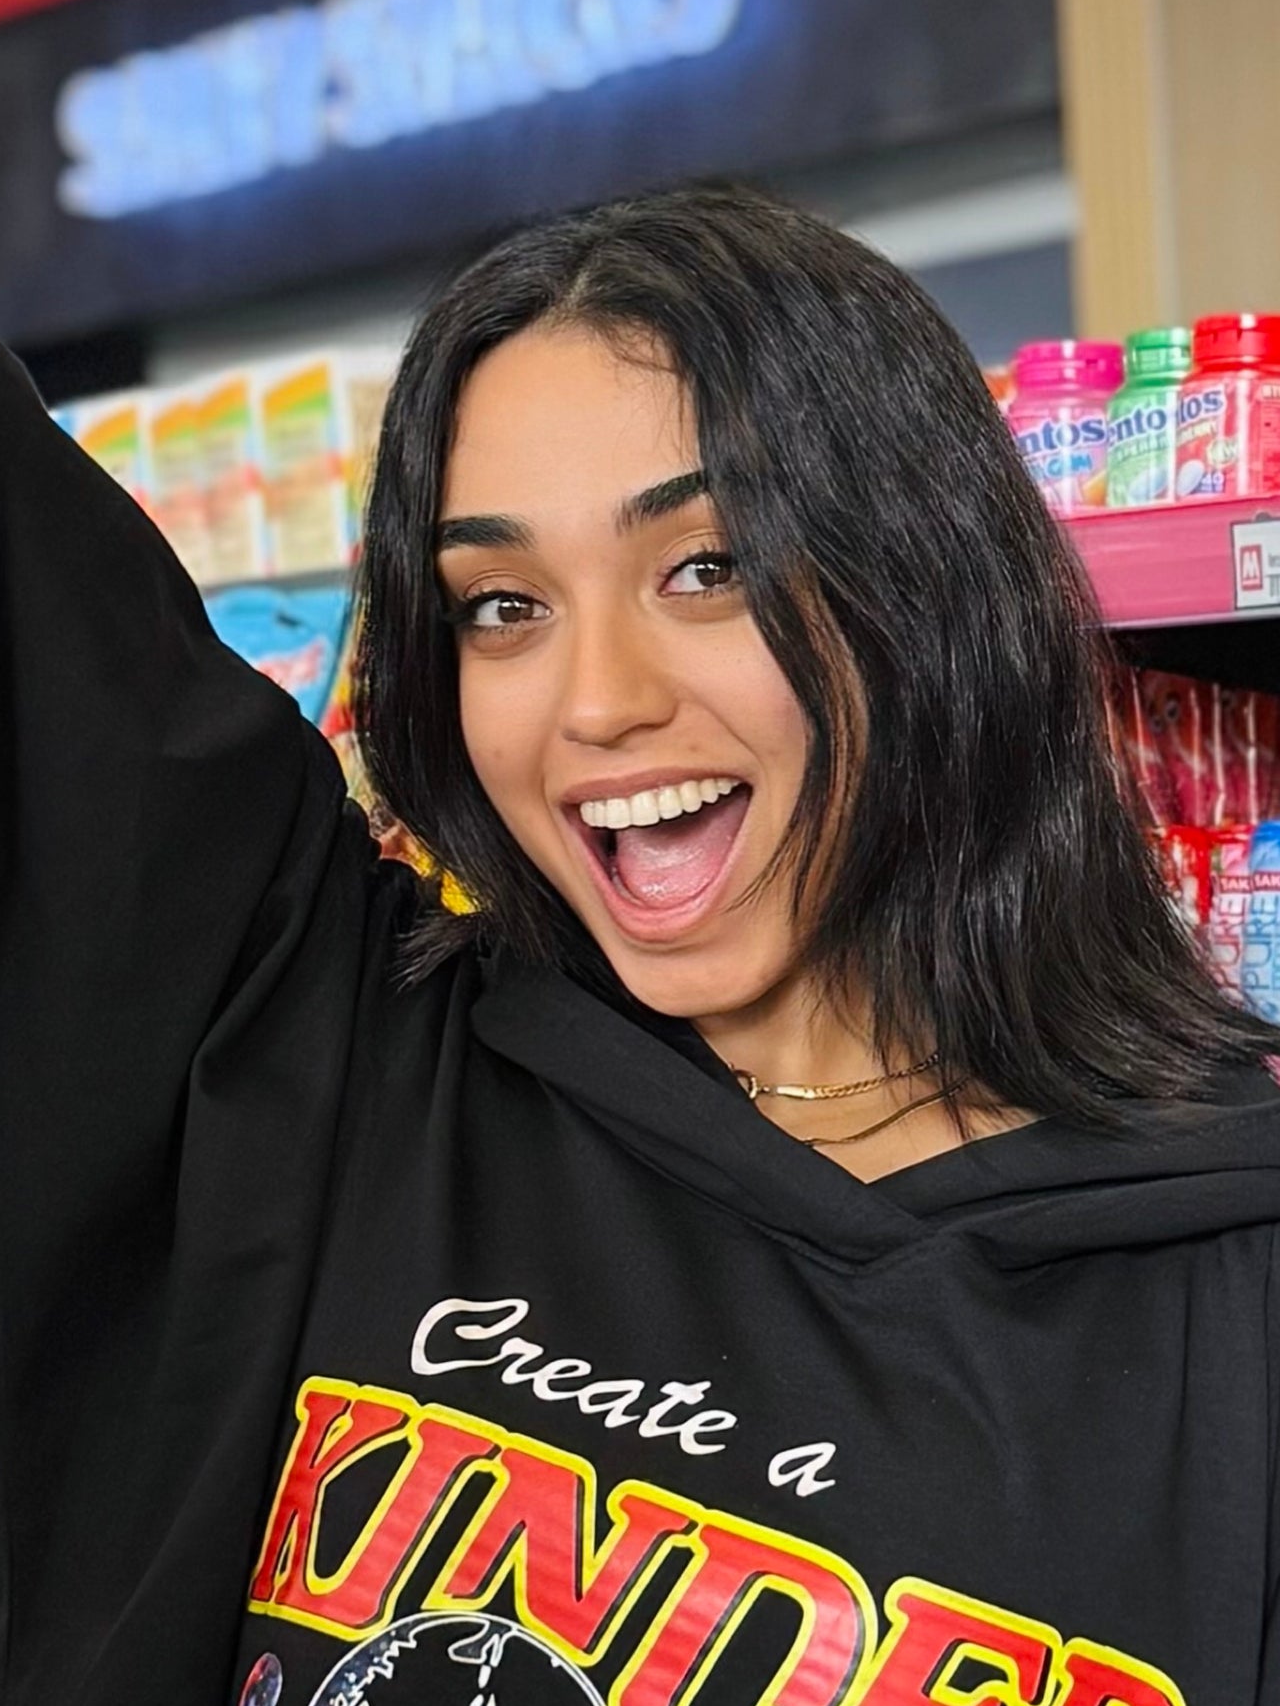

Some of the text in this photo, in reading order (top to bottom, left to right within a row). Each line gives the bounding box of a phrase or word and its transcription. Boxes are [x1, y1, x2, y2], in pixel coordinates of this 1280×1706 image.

[1017, 417, 1106, 454] ntos
[1220, 878, 1250, 891] SAK
[408, 1296, 837, 1497] Create a
